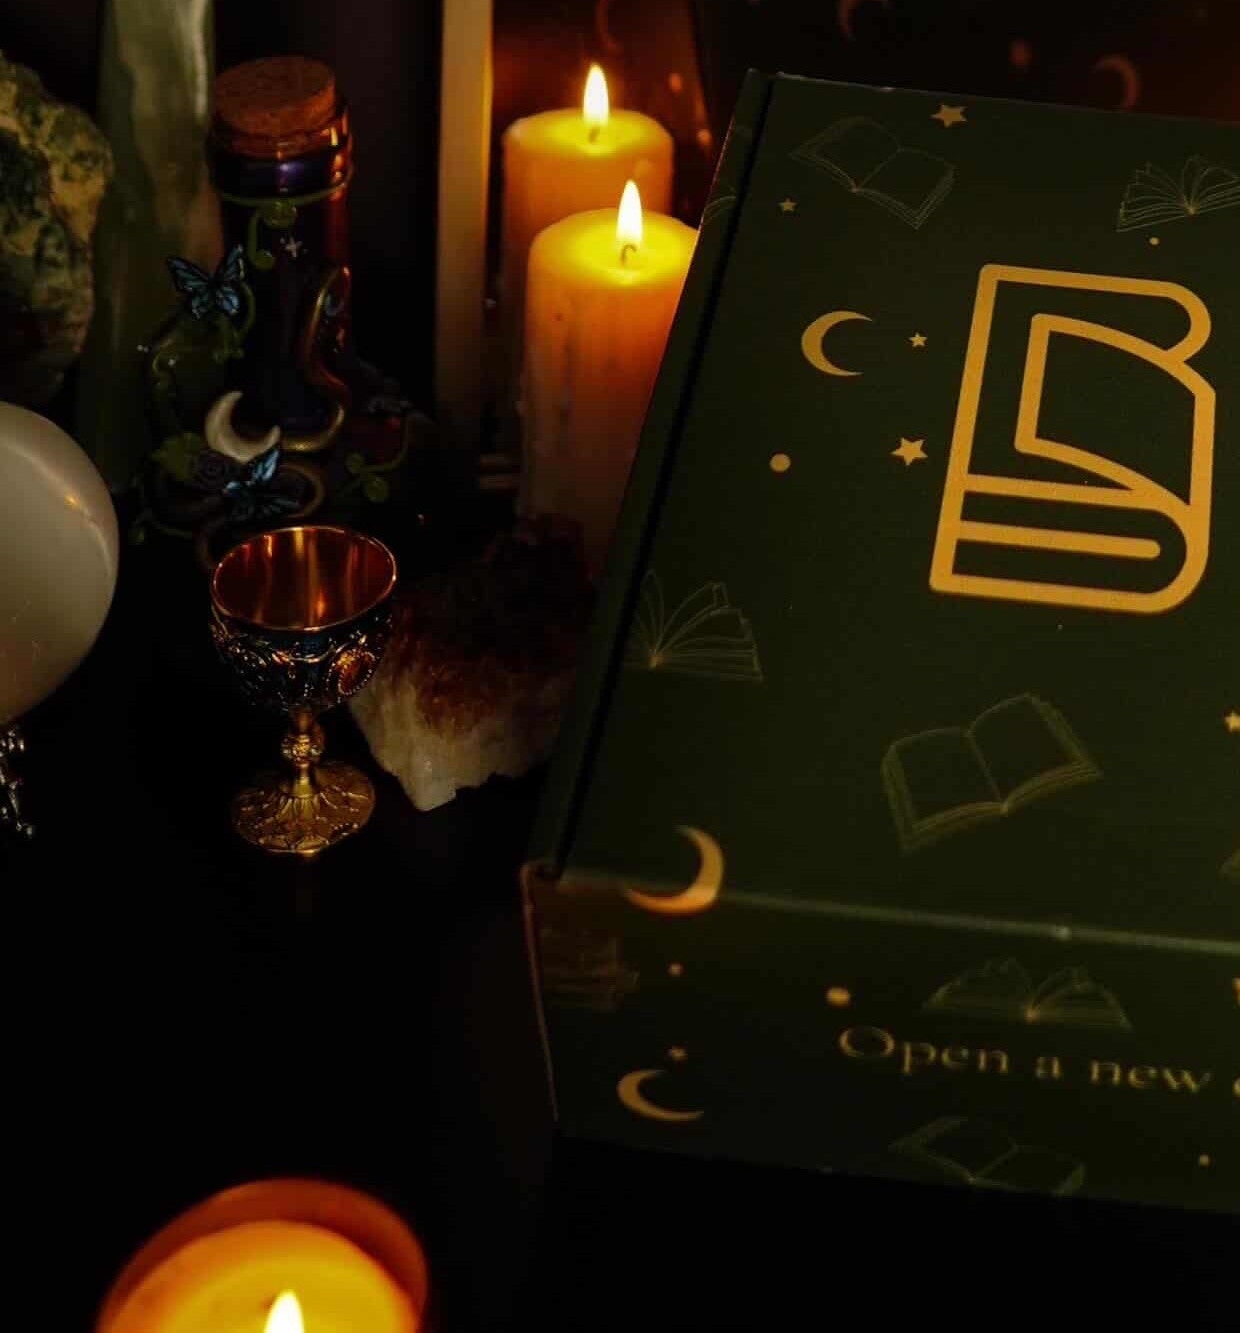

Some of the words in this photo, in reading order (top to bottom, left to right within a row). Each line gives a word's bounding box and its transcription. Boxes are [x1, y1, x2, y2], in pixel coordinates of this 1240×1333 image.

[837, 1026, 1009, 1074] Open
[1035, 1054, 1063, 1080] a
[1089, 1060, 1211, 1092] new
